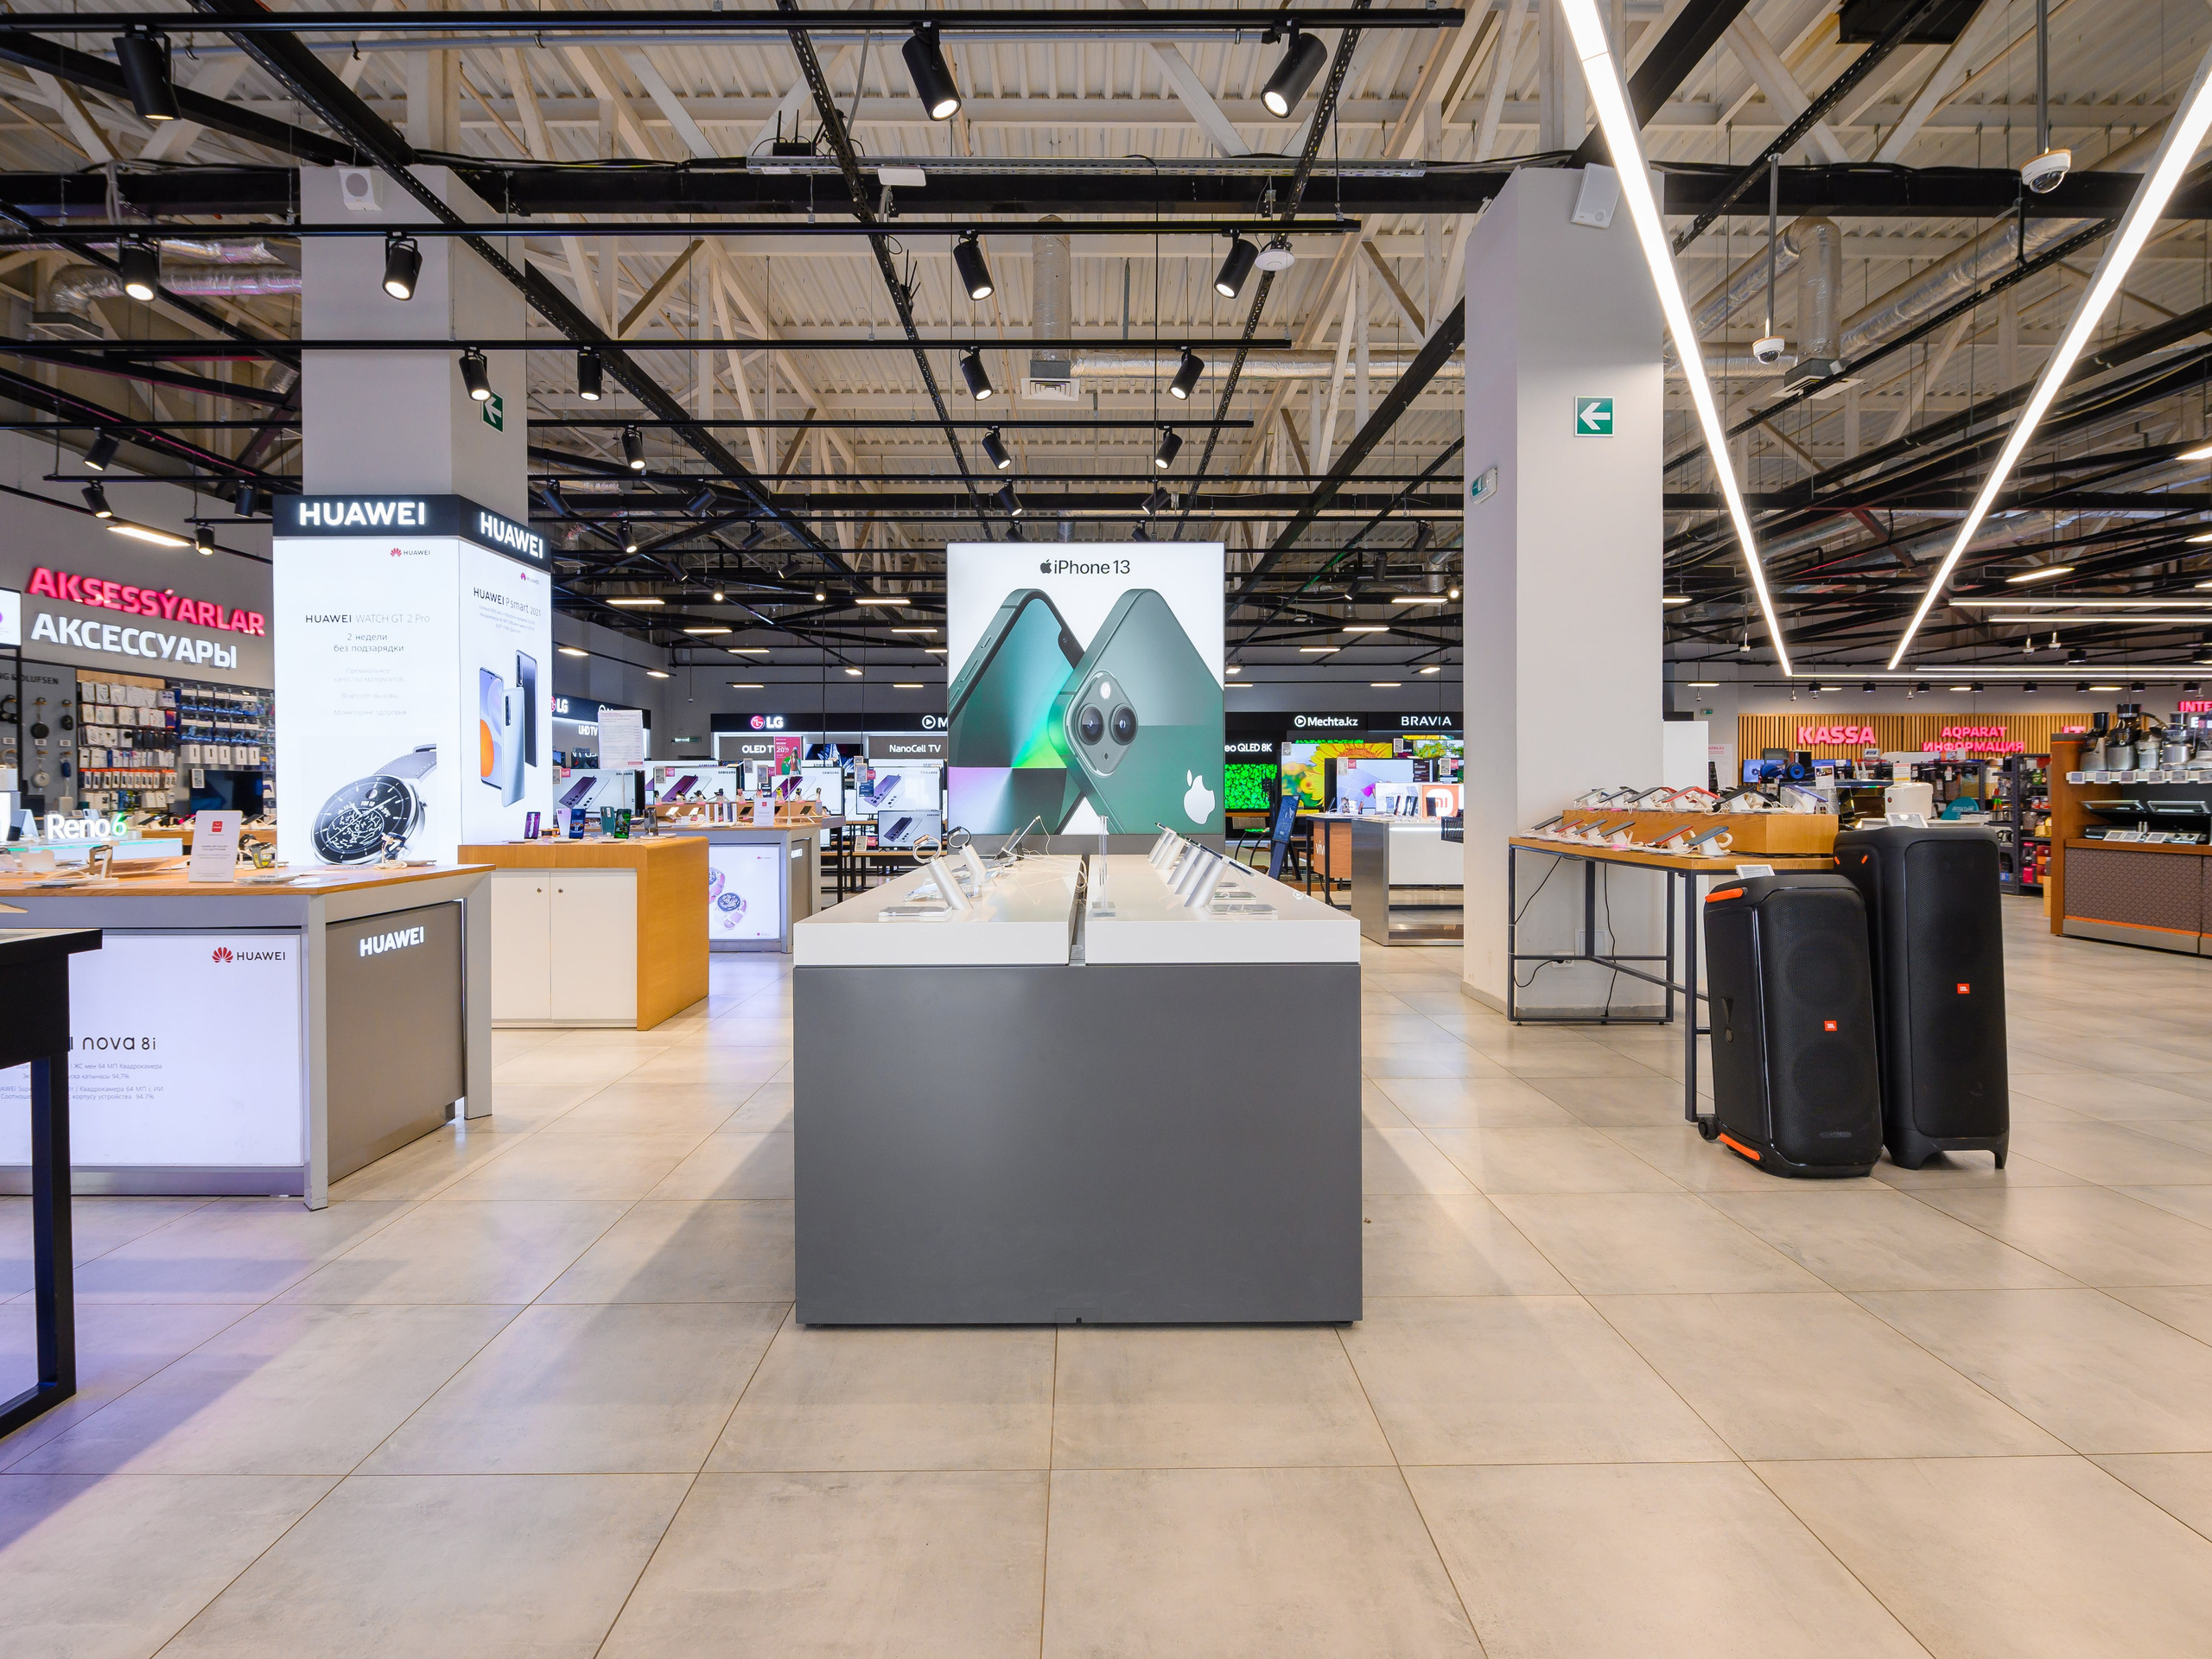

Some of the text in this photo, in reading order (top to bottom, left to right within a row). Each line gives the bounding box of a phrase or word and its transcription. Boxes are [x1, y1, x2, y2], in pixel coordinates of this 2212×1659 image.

[299, 501, 426, 526] HUAWEI
[480, 512, 543, 559] HUAWEI
[1053, 560, 1131, 575] iPhone 13
[26, 566, 266, 637] AKSESSÝARLAR
[474, 587, 505, 605] HUAWEI
[510, 600, 529, 613] smart
[530, 607, 541, 617] 2021
[305, 614, 430, 623] HUAWEI WATCH GT 2 Pro
[31, 613, 237, 669] АКСЕССУАРЫ
[556, 697, 569, 714] LG
[766, 716, 784, 728] LG
[1307, 715, 1358, 727] Mechta.kz
[1401, 715, 1452, 726] BRAVIA
[1797, 725, 1877, 745] KASSA
[1941, 726, 2007, 740] AQPARAT
[741, 745, 766, 753] OLED
[889, 744, 942, 753] NanoCell TV
[1237, 743, 1261, 753] QLED
[1261, 743, 1273, 752] 8K
[1922, 741, 2024, 753] ИНФОРМАЦИЯ
[47, 811, 129, 840] Reno6
[359, 925, 424, 957] HUAWEI
[236, 951, 286, 961] HUAWEI
[82, 1036, 135, 1051] nova
[141, 1037, 156, 1051] 8i
